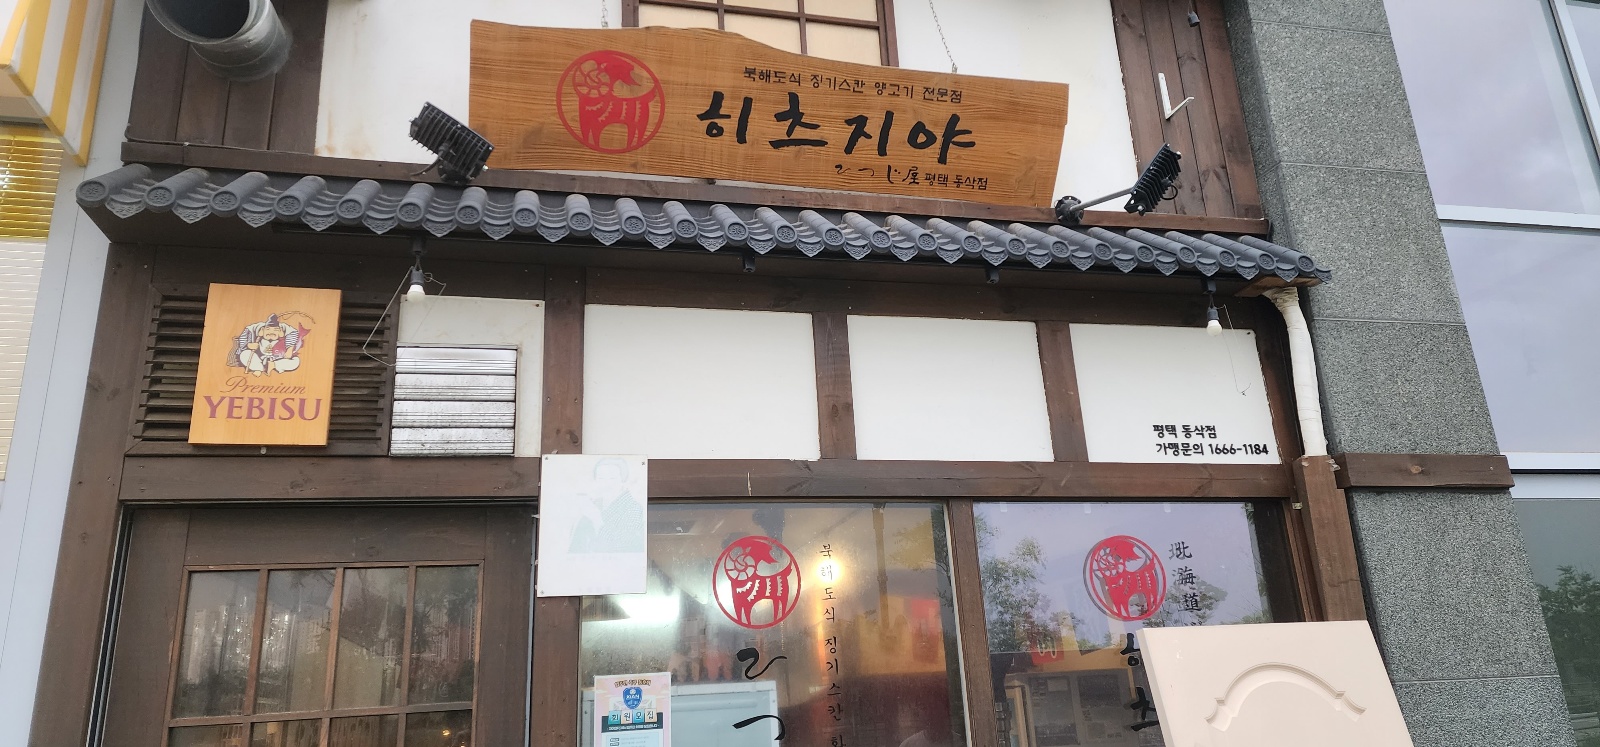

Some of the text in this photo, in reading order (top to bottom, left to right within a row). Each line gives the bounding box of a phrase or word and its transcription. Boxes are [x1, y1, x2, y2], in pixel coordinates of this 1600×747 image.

[744, 66, 963, 104] 북해도식 징기스칸 양고기 전문점
[696, 91, 976, 165] 히츠지야
[924, 173, 949, 187] 평택
[953, 175, 988, 190] 동삭점
[220, 376, 306, 394] Premium
[203, 396, 322, 421] YEBISU
[1152, 424, 1217, 439] 평택 동삭점
[1155, 442, 1269, 456] 가맹문의 1666-1184
[819, 544, 837, 623] 북해도식
[824, 636, 844, 721] 징기스칸
